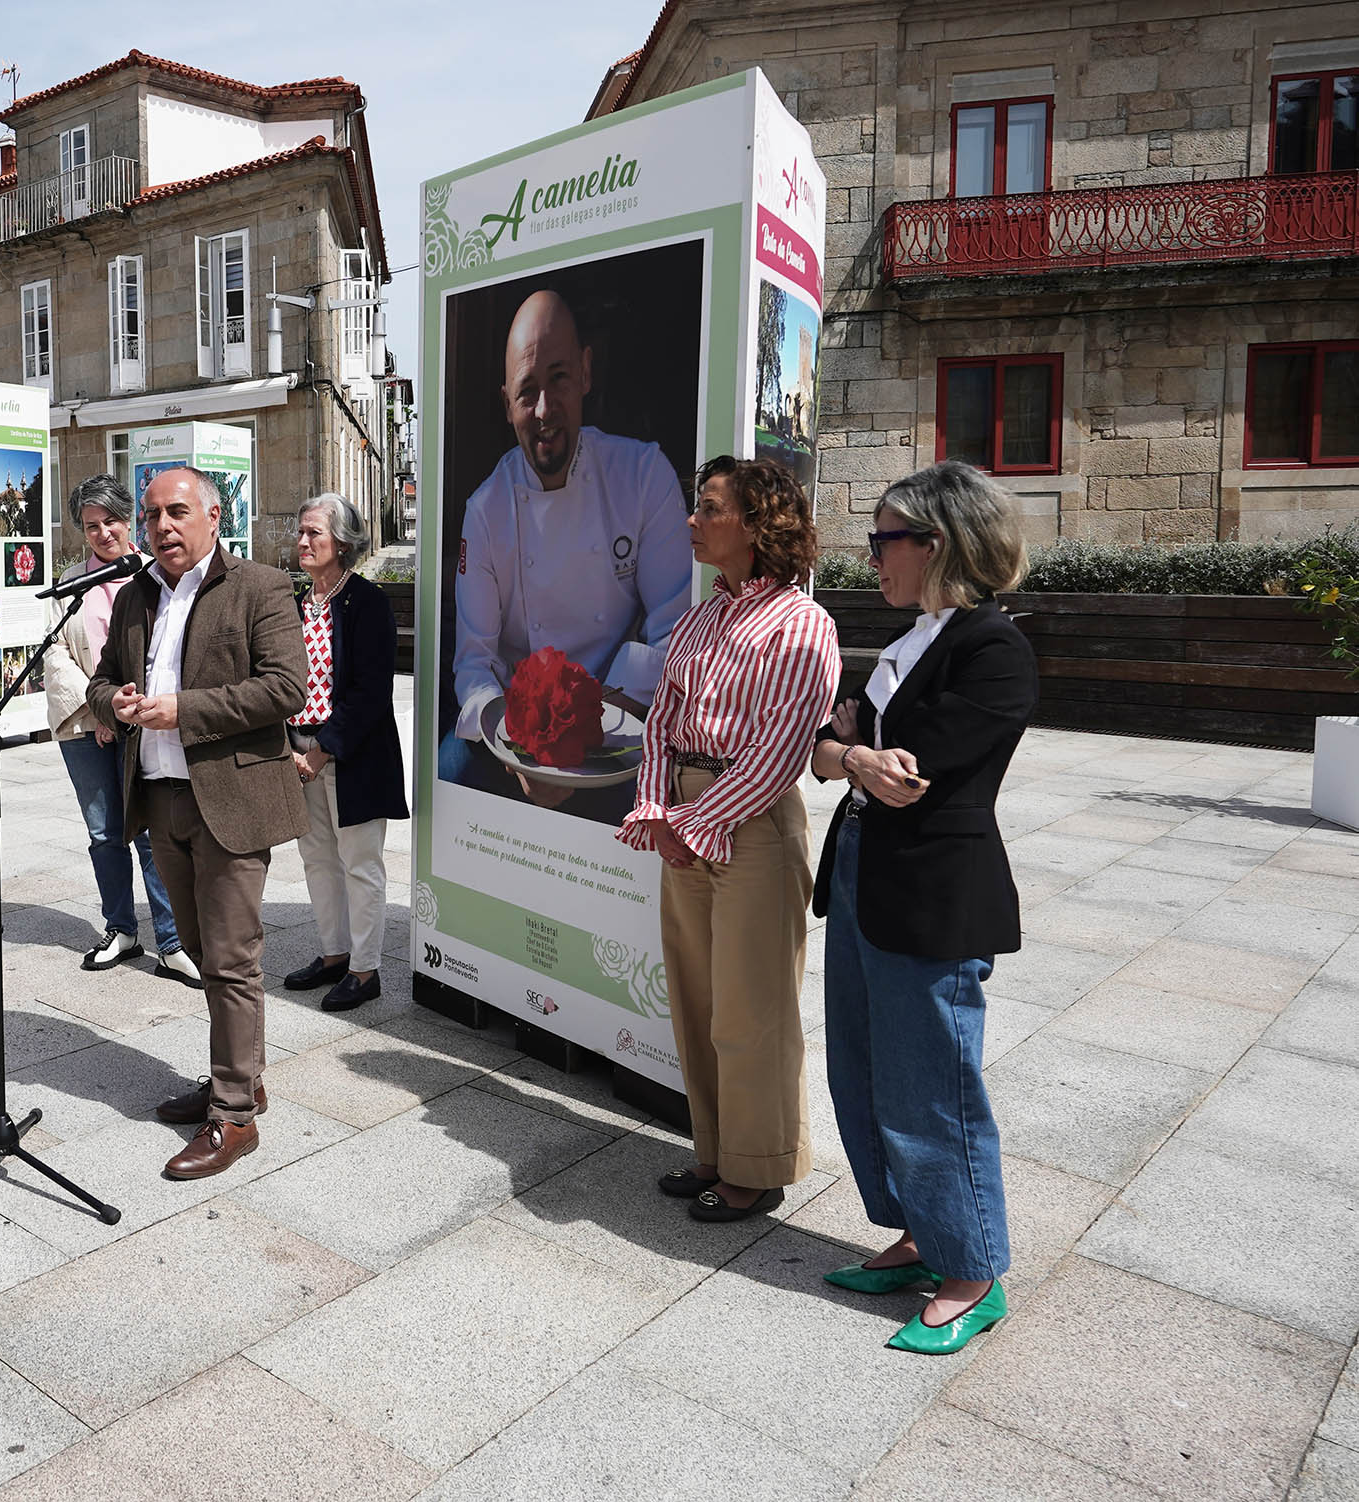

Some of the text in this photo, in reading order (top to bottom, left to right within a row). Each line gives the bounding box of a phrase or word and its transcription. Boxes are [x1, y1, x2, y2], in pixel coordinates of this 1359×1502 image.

[480, 153, 642, 248] A camelia
[530, 196, 639, 234] flor das galegas e galegos
[140, 436, 151, 454] A
[465, 839, 478, 851] que
[500, 852, 542, 872] pretendemos
[581, 878, 594, 889] coa
[596, 882, 616, 895] nosa
[479, 827, 504, 842] camelia
[512, 838, 521, 848] un
[523, 840, 546, 856] pracer
[547, 848, 565, 861] para
[568, 852, 587, 867] todos
[590, 861, 599, 871] os
[601, 864, 636, 883] sentidos.
[444, 953, 479, 974] Deputación
[444, 962, 479, 983] Pontevedra
[526, 989, 544, 1007] SEC
